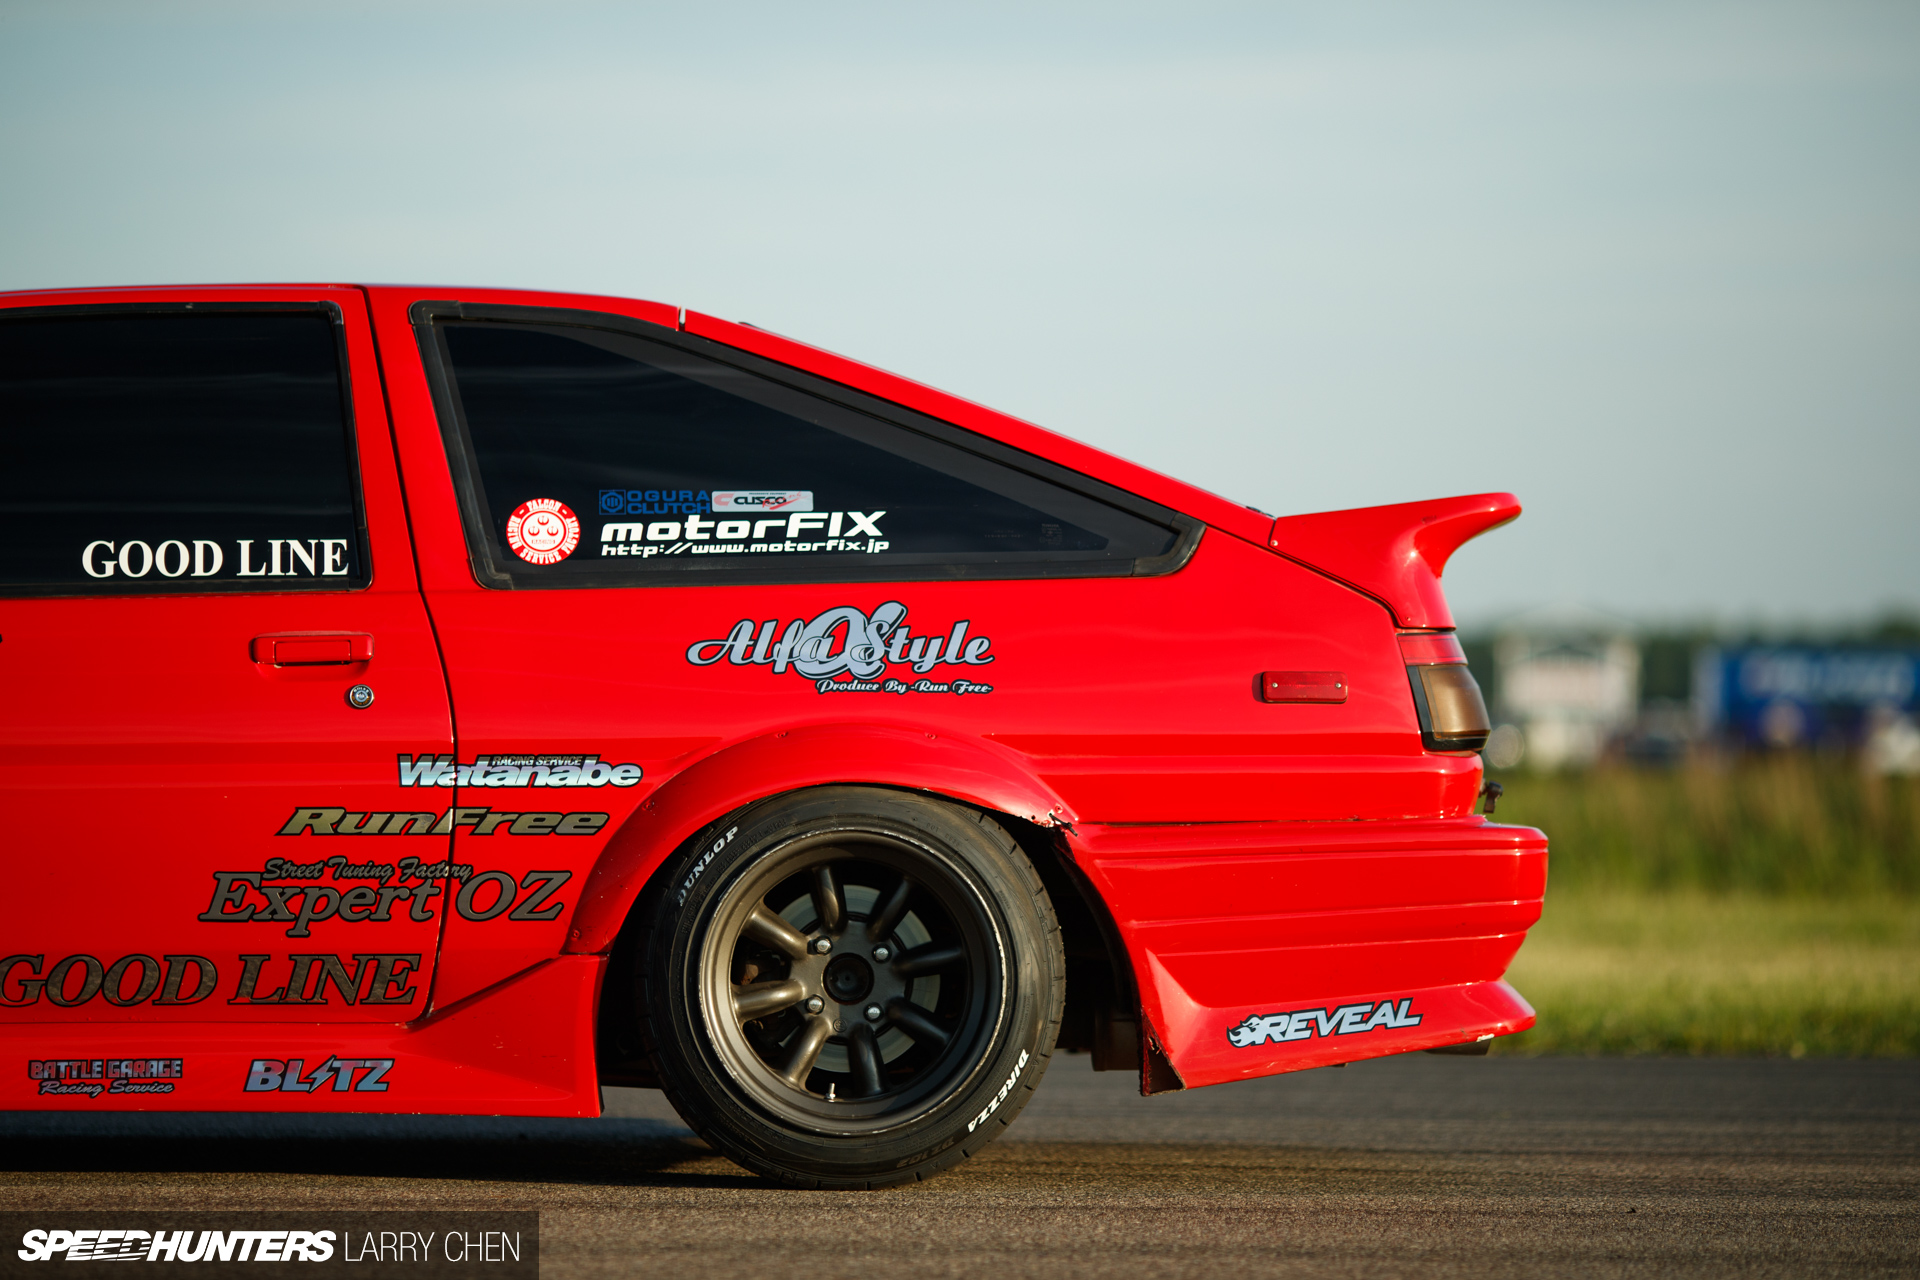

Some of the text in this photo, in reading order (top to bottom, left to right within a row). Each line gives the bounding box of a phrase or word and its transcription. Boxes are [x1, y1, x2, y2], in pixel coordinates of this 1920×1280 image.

[526, 499, 562, 512] FALCON
[627, 490, 710, 501] OGURA
[627, 502, 710, 514] CLUTCH
[600, 511, 887, 542] motorFIX
[82, 538, 349, 578] GOOD LINE
[519, 548, 562, 564] SERVICE
[601, 539, 889, 558] http://www.motorfix.jp
[850, 618, 995, 674] Style
[816, 679, 880, 694] Produce
[885, 679, 907, 694] By
[397, 754, 643, 787] Watanabe
[492, 756, 582, 766] RACING SERVICE
[262, 856, 473, 885] Street Tuning Factory
[678, 826, 738, 906] DUNLOP
[198, 870, 572, 937] Expert OZ
[0, 954, 422, 1007] GOOD LINE
[1248, 997, 1423, 1046] REVEAL
[29, 1058, 183, 1079] BATTLE GARAGE
[38, 1079, 175, 1098] Racing Service
[967, 1049, 1029, 1133] DIREZZA
